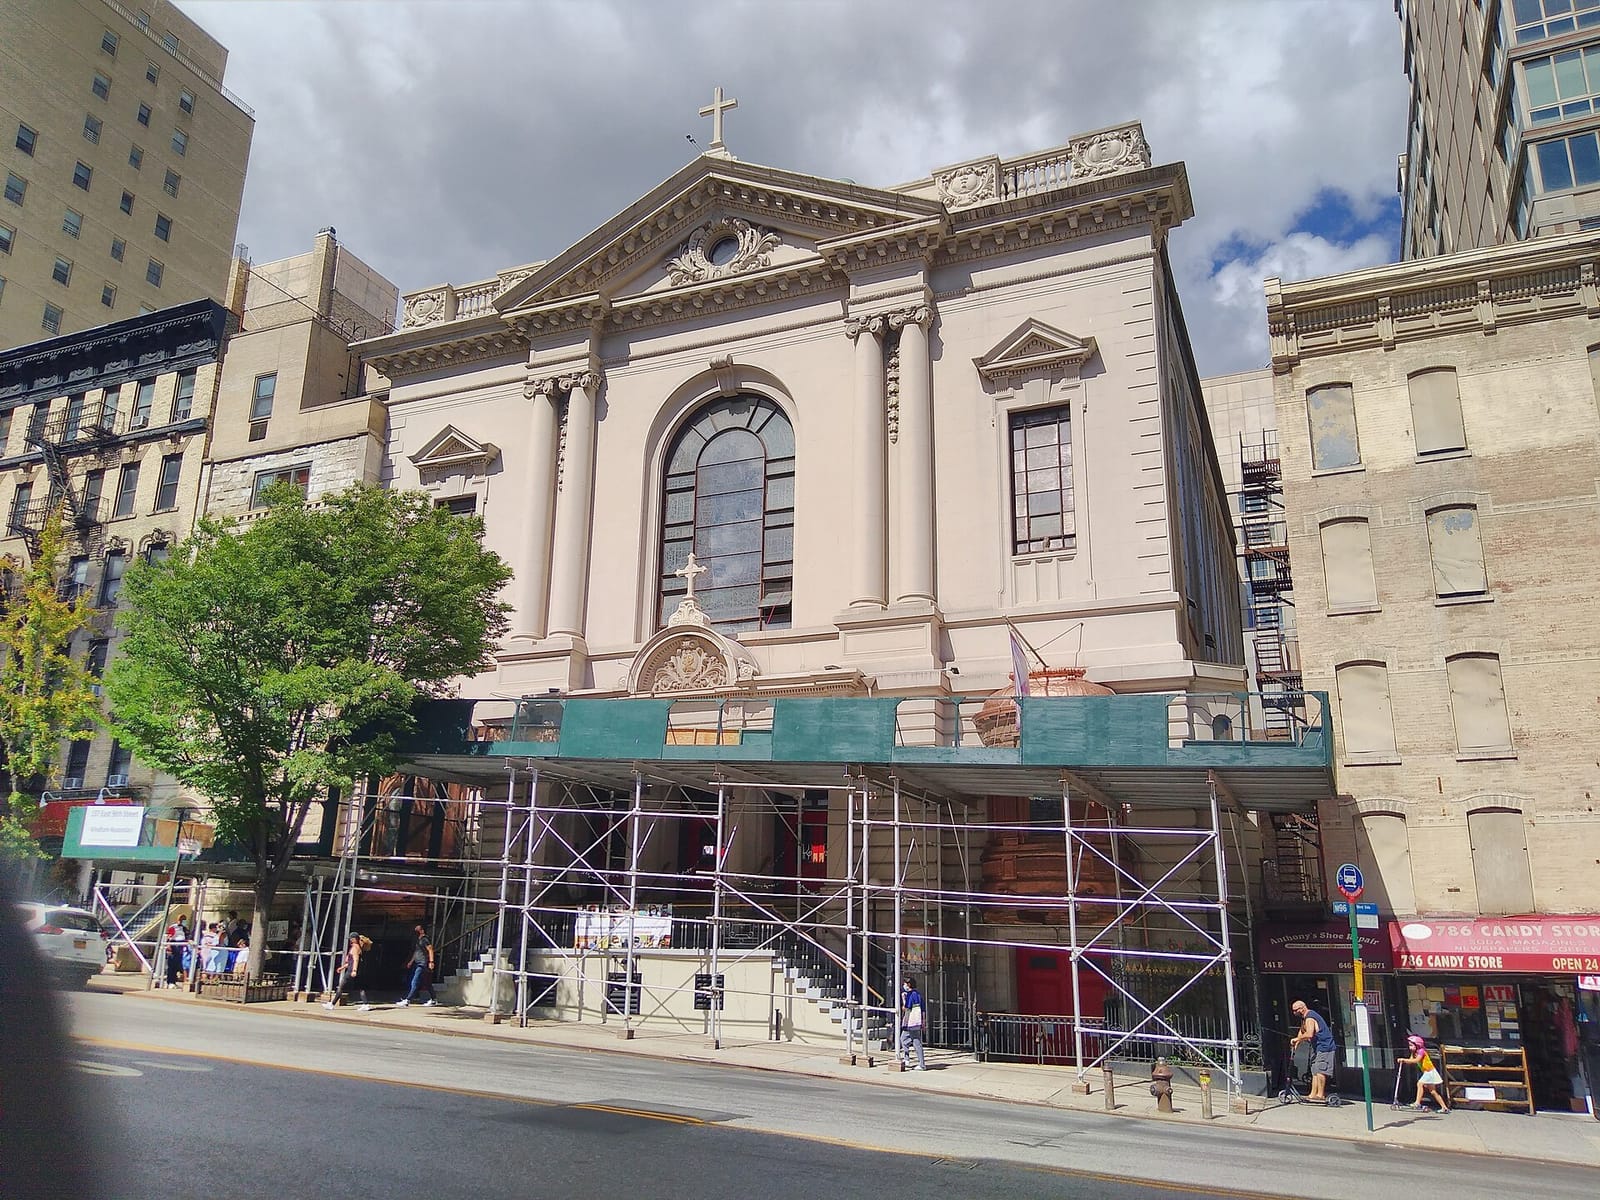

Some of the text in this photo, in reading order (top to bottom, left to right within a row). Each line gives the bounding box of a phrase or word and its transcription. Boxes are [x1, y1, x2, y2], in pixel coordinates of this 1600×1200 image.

[1435, 925, 1473, 937] 786
[1480, 925, 1543, 937] CANDY
[1270, 931, 1380, 945] Anthony's Shoe Rpair
[1263, 961, 1276, 969] 141
[1400, 954, 1503, 968] 786 CANDY STORE
[1552, 957, 1599, 970] OPEN 24
[1484, 986, 1516, 1000] ATM
